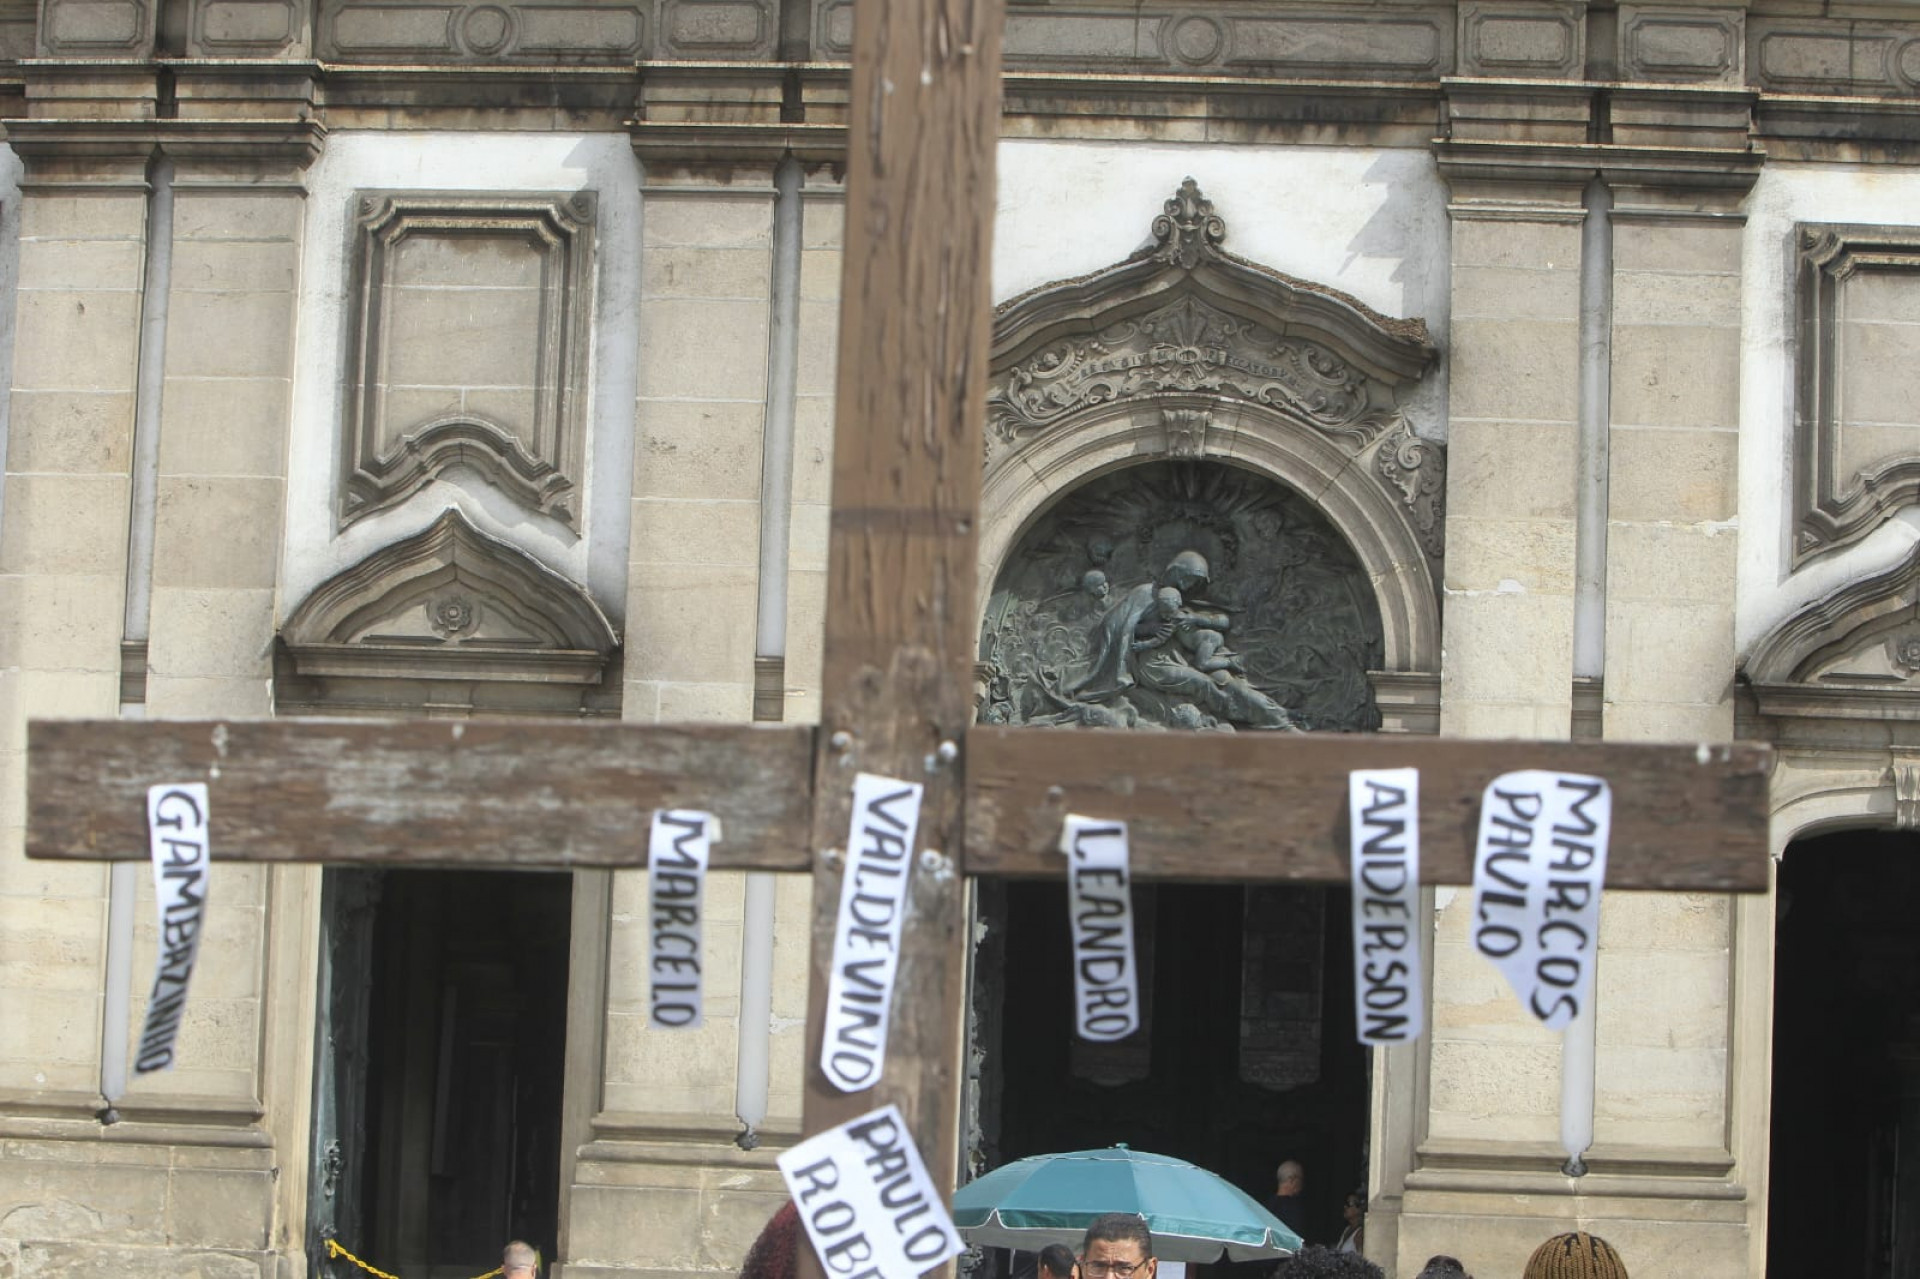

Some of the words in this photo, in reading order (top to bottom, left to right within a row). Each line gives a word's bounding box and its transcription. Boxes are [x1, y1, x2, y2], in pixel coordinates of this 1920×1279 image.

[135, 791, 203, 1074] GAMBAZINHO
[652, 812, 705, 1028] MARCELO
[830, 788, 914, 1084] VALDEVINO
[1074, 827, 1131, 1036] LEANDRO
[1360, 779, 1411, 1042] ANDERSON
[1476, 788, 1544, 959] PAULO
[1530, 778, 1604, 1023] MARCOS
[846, 1113, 949, 1263] PAULO
